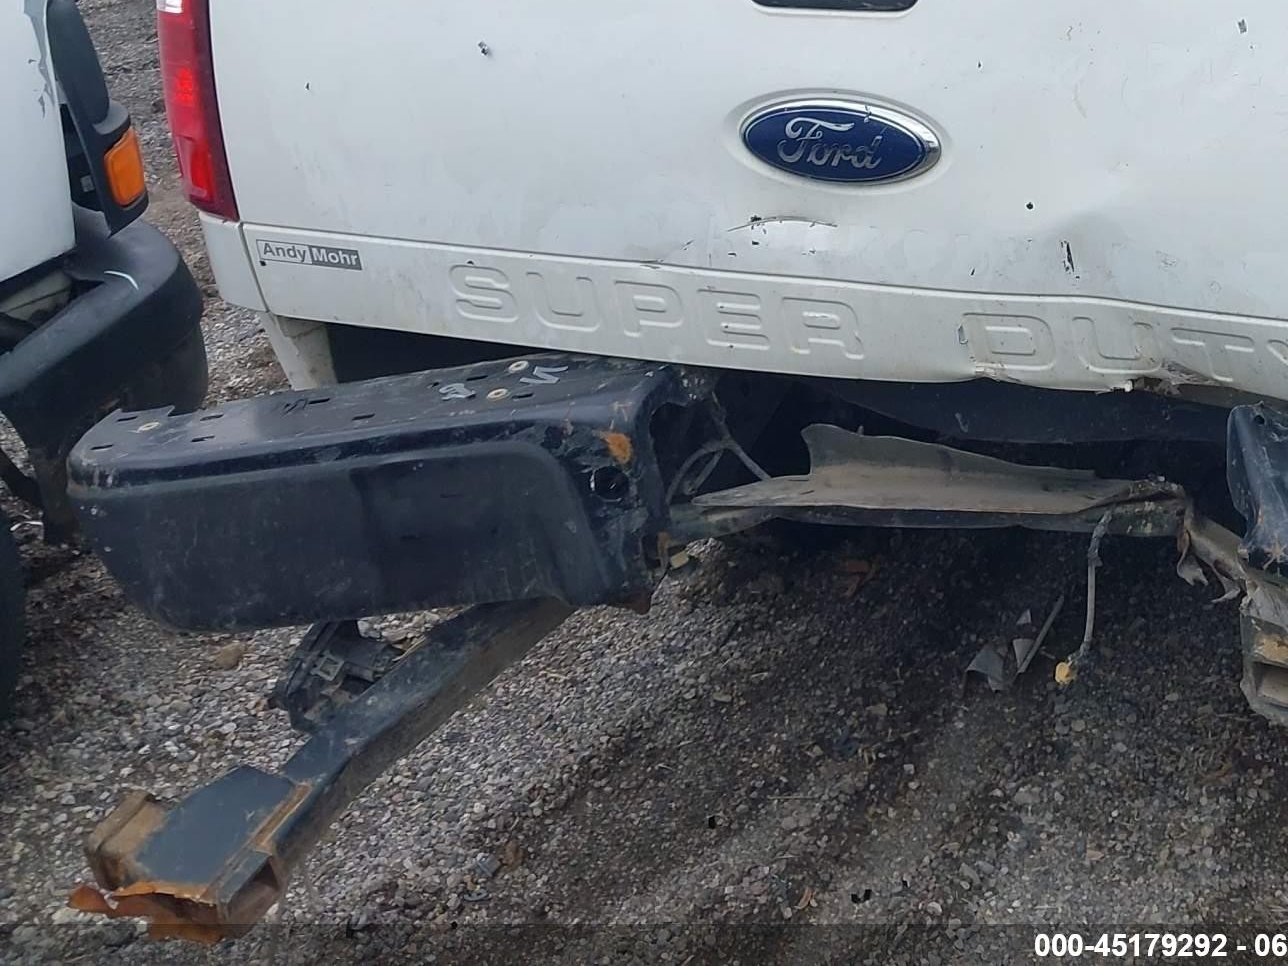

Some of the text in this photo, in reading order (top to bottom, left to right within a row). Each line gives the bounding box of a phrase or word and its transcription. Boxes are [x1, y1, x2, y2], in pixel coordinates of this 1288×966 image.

[777, 117, 884, 170] Ford
[263, 242, 358, 266] Andy Mohr
[448, 264, 865, 361] SUPER
